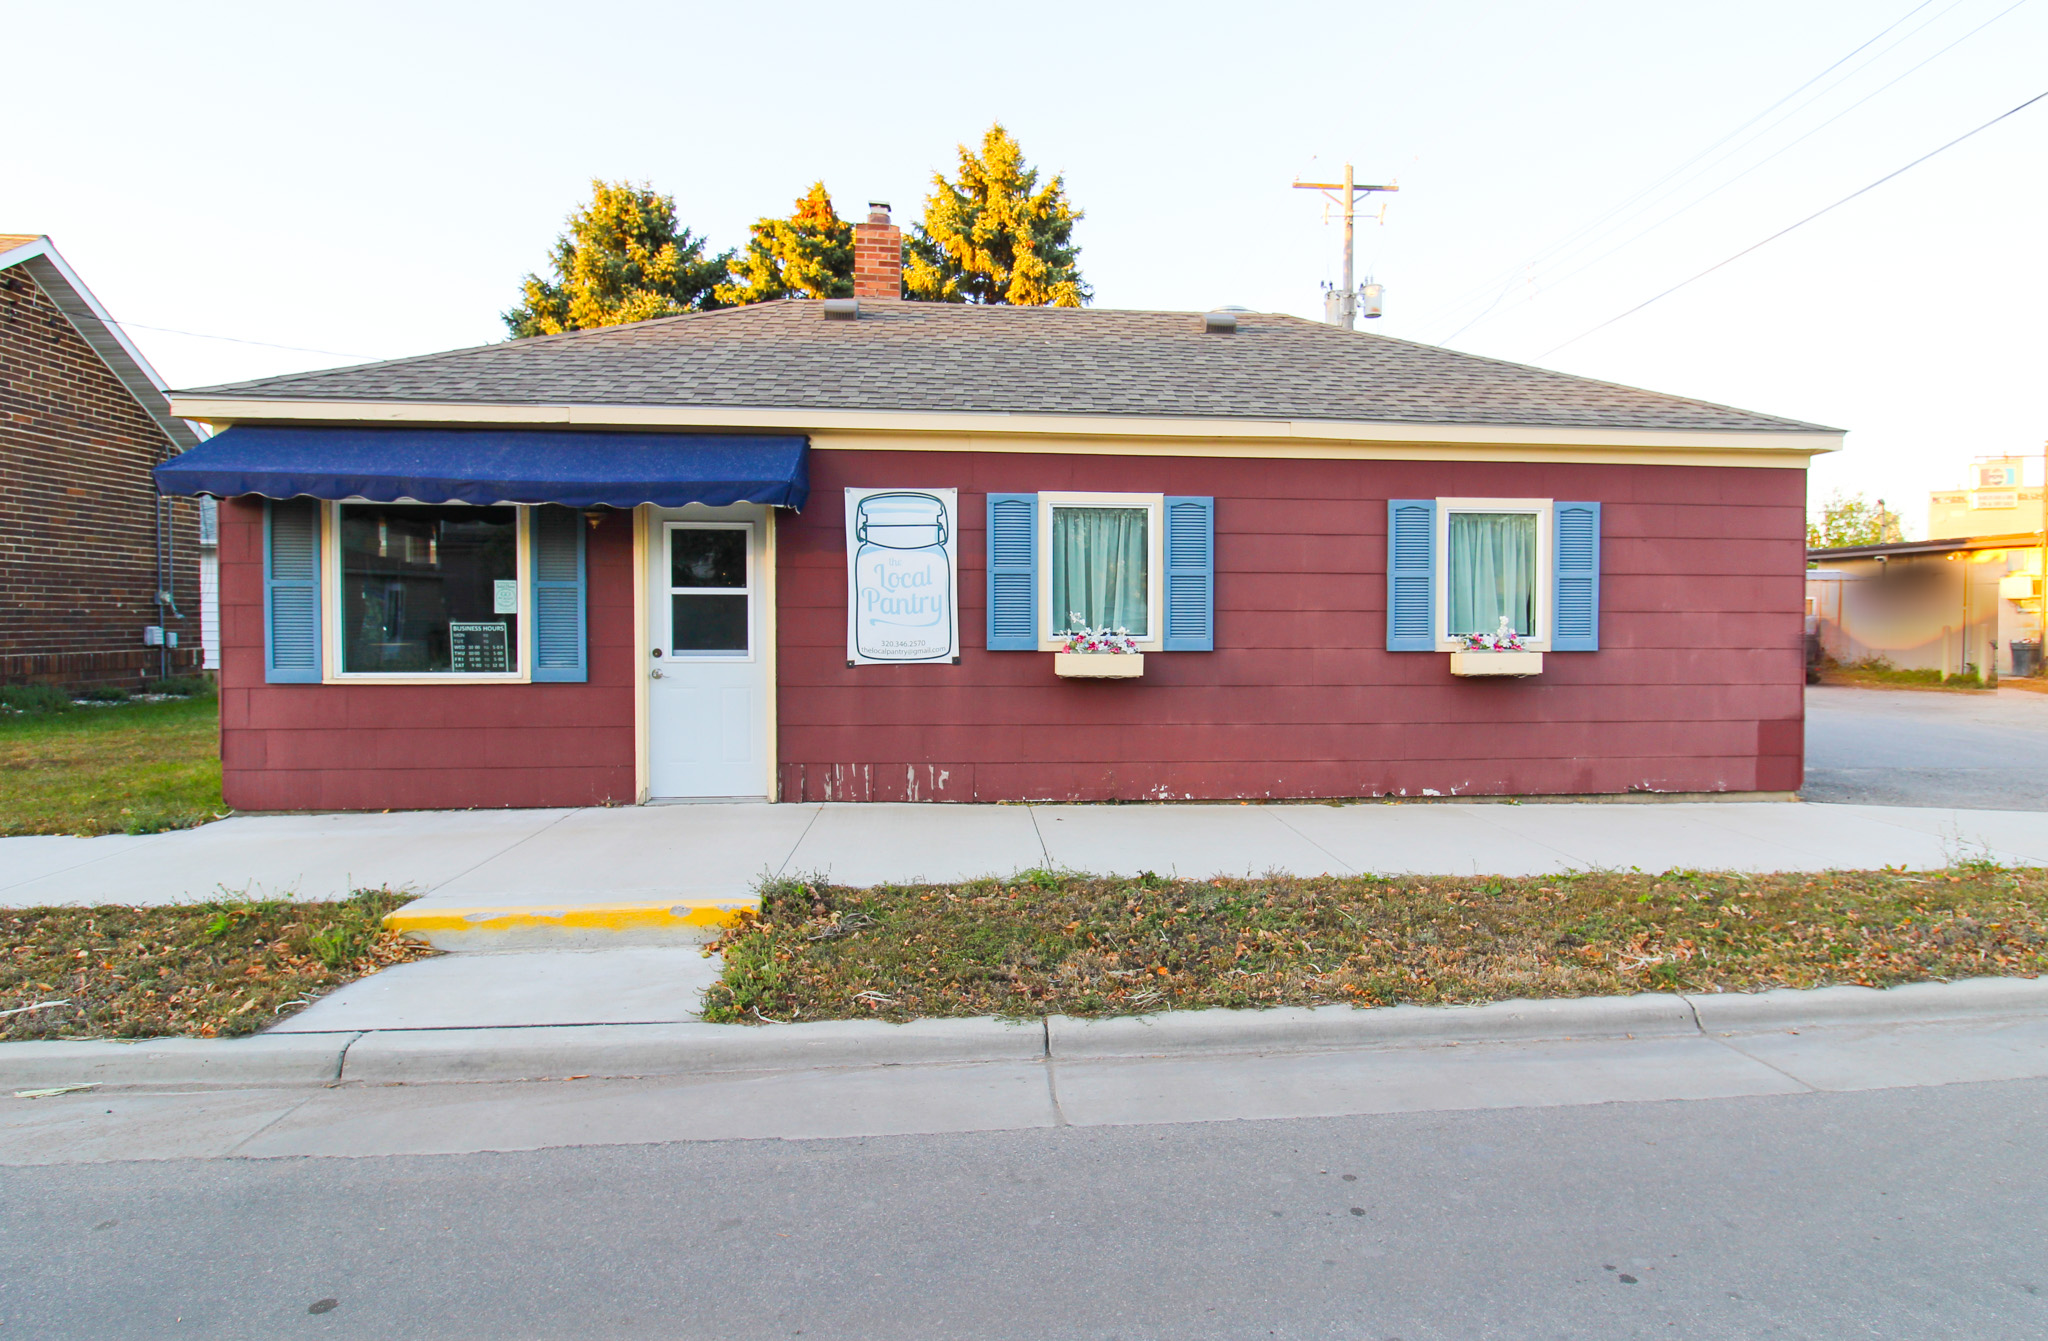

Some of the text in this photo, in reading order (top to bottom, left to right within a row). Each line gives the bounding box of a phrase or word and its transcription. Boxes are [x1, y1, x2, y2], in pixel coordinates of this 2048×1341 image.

[888, 557, 902, 567] the
[873, 563, 933, 593] Local
[861, 586, 942, 627] Pantry
[861, 646, 946, 656] thelocalpantry@gmail.com
